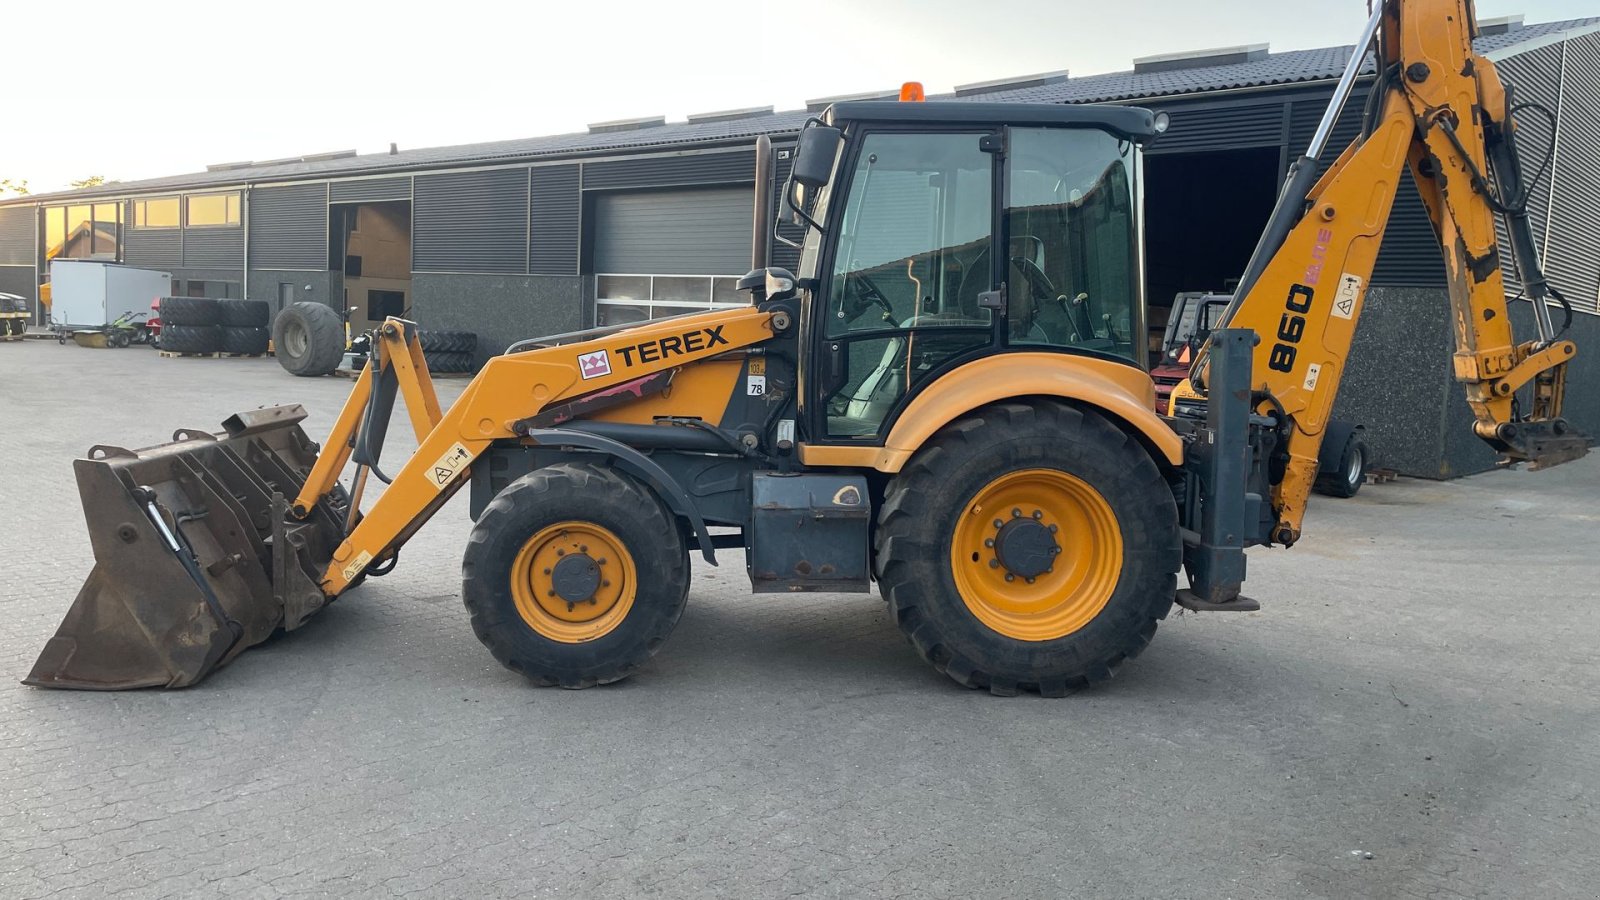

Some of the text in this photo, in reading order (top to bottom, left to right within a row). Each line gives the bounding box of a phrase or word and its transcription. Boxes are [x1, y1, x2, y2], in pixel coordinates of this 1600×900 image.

[615, 324, 729, 367] TEREX
[1268, 283, 1314, 373] 860
[751, 384, 763, 394] 78
